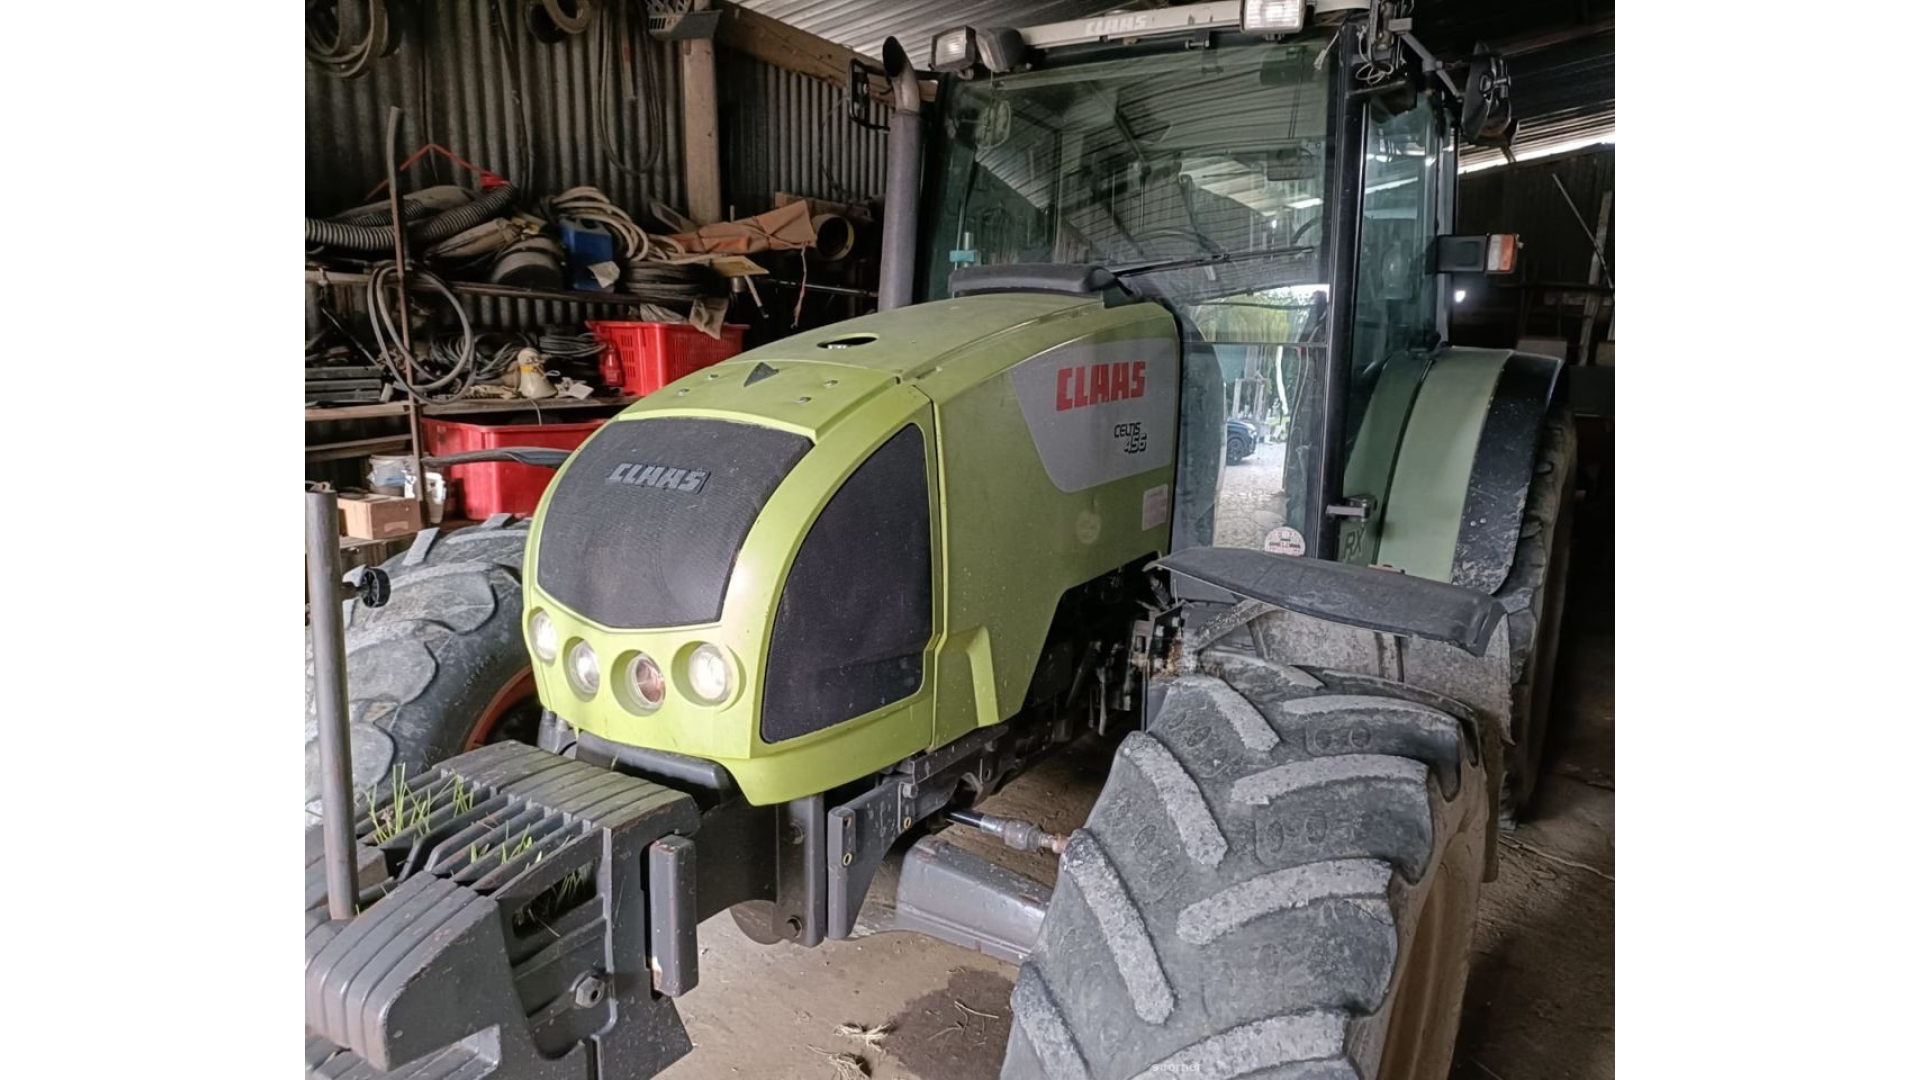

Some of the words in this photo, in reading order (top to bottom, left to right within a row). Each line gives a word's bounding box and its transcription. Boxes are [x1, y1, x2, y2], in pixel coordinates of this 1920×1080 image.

[1085, 14, 1147, 36] CLAAS
[1056, 360, 1146, 412] CLAAS
[1114, 422, 1142, 438] CELTIS
[1123, 433, 1148, 454] 456
[608, 463, 707, 492] CLAAS
